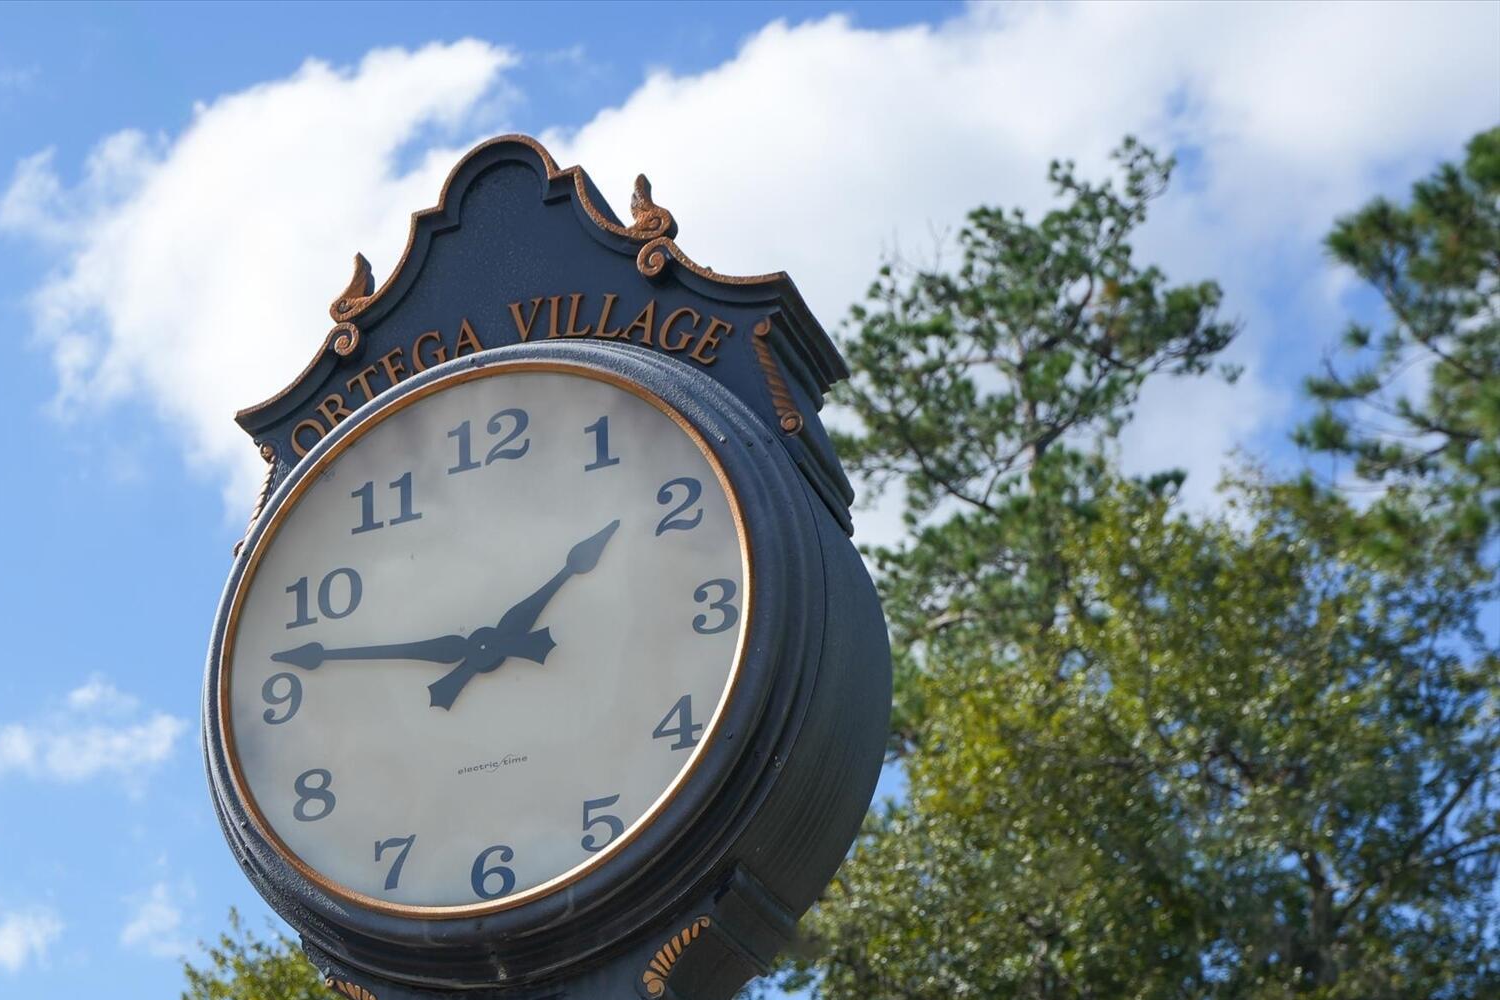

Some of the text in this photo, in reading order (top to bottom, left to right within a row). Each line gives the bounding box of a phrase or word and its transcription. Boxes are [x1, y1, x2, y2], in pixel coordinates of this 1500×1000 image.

[290, 293, 734, 460] ORTEGA VILLAGE
[447, 407, 531, 475] 12
[583, 415, 621, 472] 1
[349, 471, 423, 536] 11
[654, 476, 704, 537] 2
[284, 567, 363, 631] 10
[691, 578, 739, 635] 3
[261, 671, 303, 726] 9
[651, 694, 704, 752] 4
[457, 755, 528, 775] electric time
[292, 768, 337, 823] 8
[580, 793, 625, 854] 5
[374, 833, 417, 892] 7
[470, 845, 516, 900] 6
